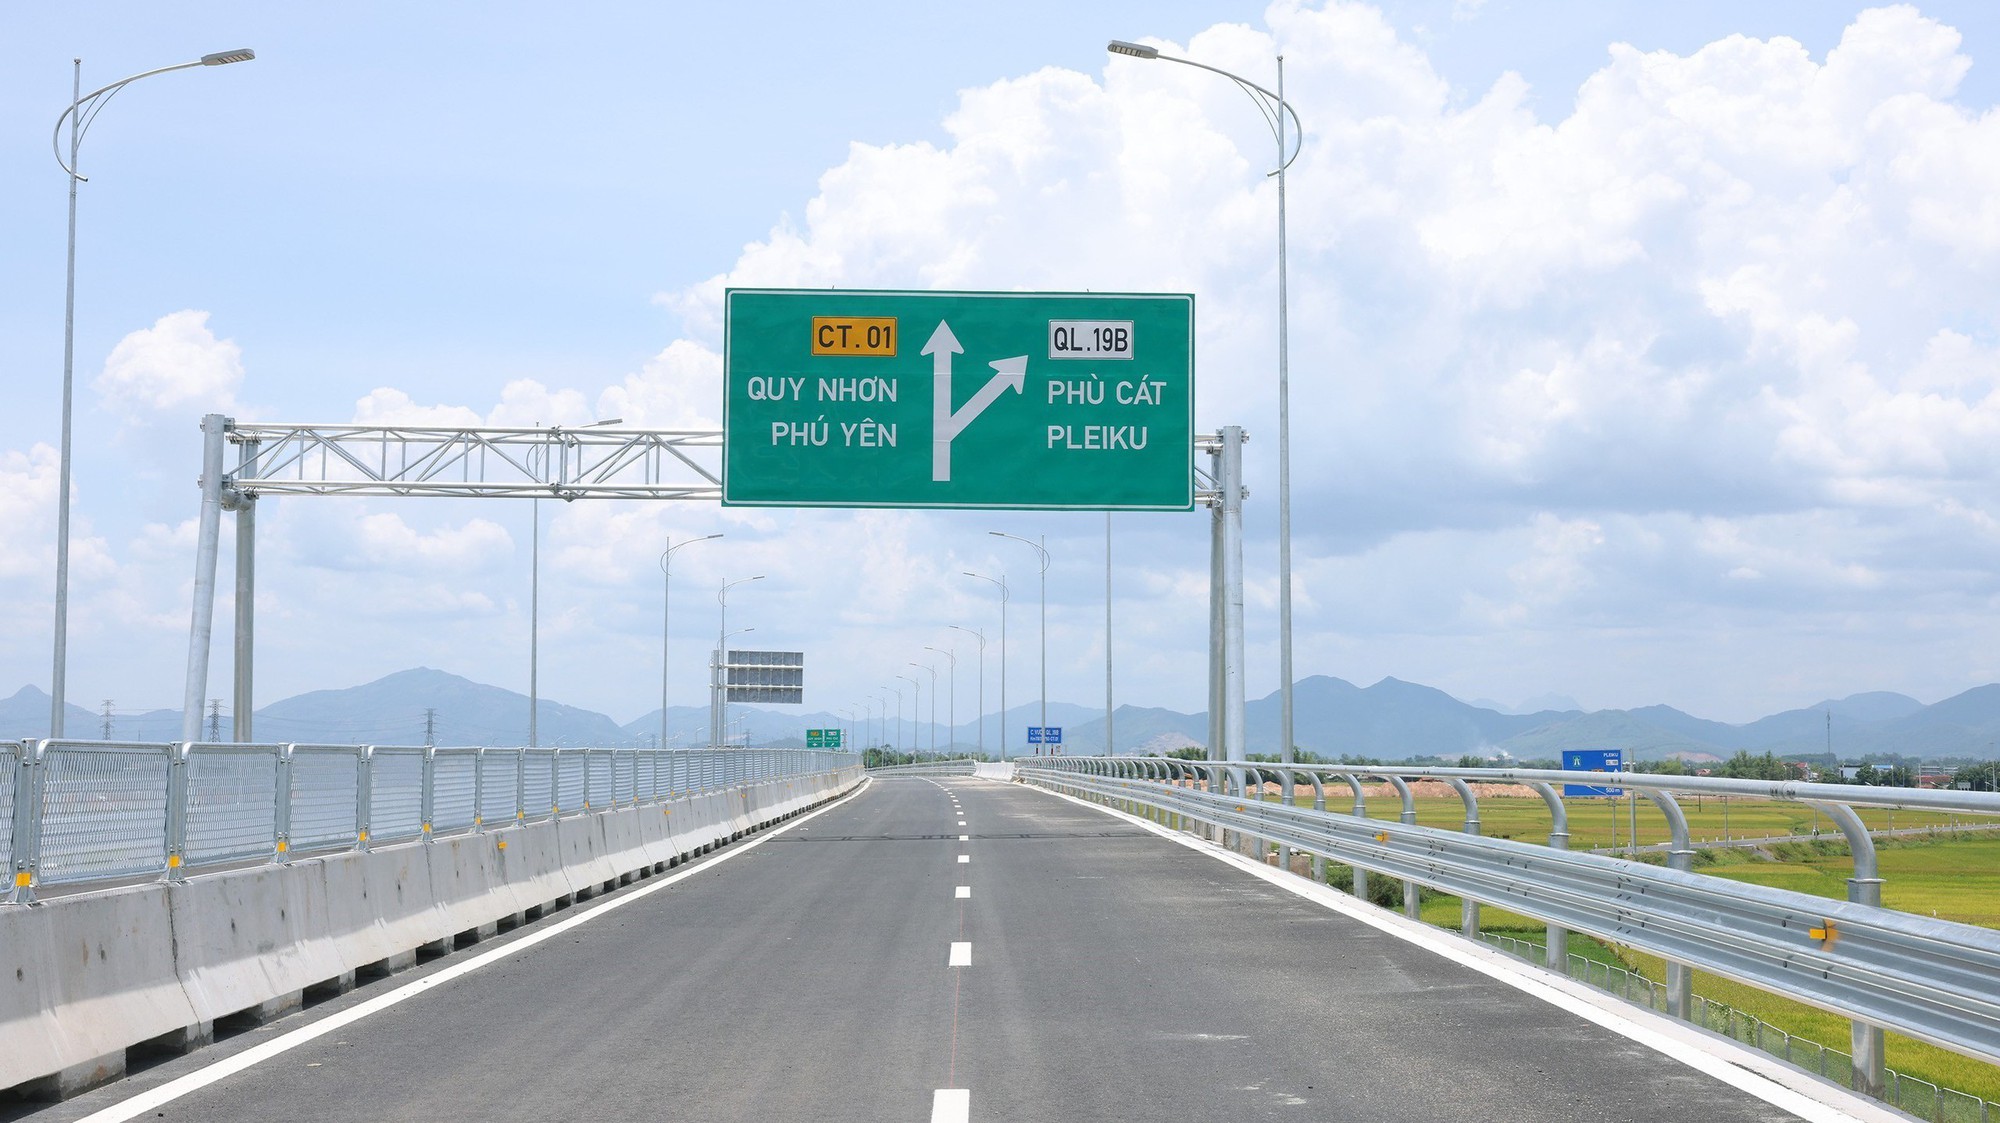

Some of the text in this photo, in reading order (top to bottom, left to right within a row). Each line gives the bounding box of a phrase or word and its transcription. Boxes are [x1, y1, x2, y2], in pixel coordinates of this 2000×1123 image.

[1054, 327, 1128, 352] QL.19B
[748, 376, 897, 403] QUY NHƠN
[1048, 373, 1167, 405] PHÙ CÁT
[772, 415, 897, 447] PHÚ YÊN
[1048, 426, 1148, 450] PLEIKU
